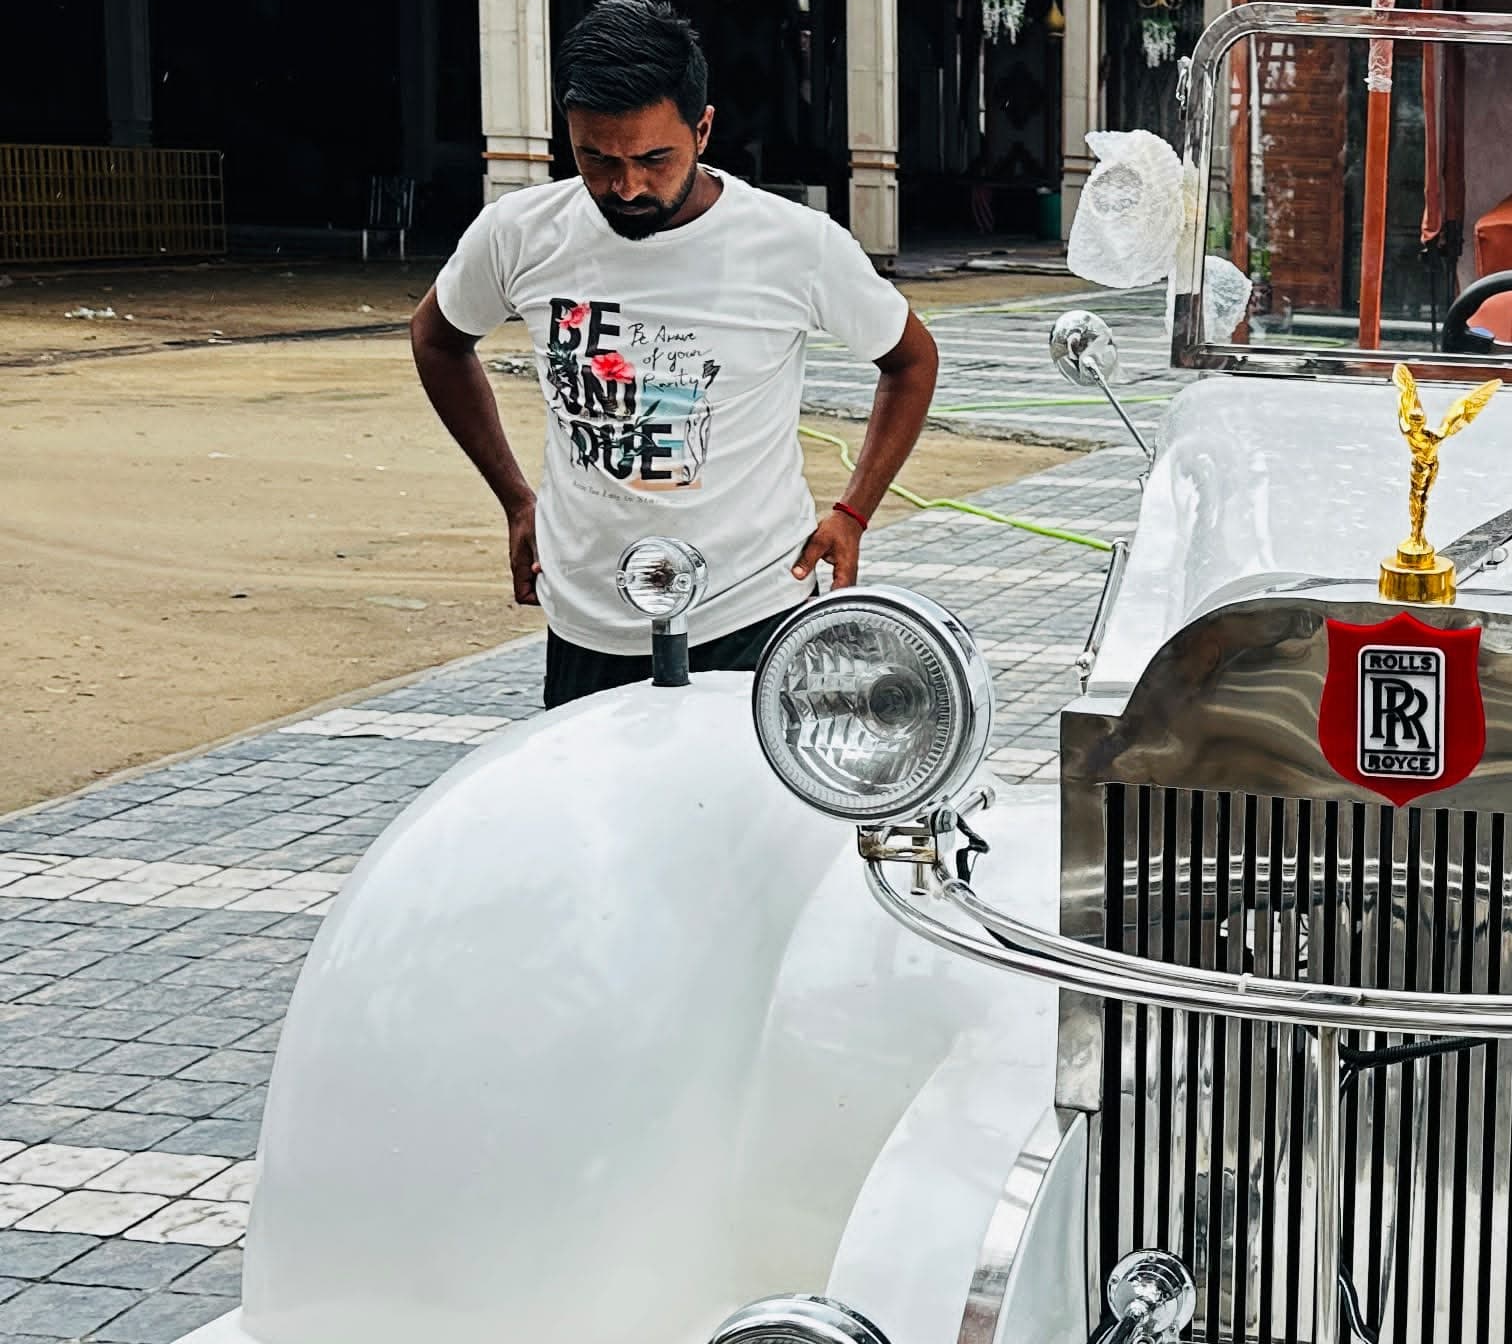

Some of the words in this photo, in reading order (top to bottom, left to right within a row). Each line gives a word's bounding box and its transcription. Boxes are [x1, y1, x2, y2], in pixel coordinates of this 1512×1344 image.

[549, 298, 621, 357] BE
[643, 348, 664, 370] of
[1369, 654, 1433, 671] ROLLS
[1368, 755, 1432, 771] ROYCE
